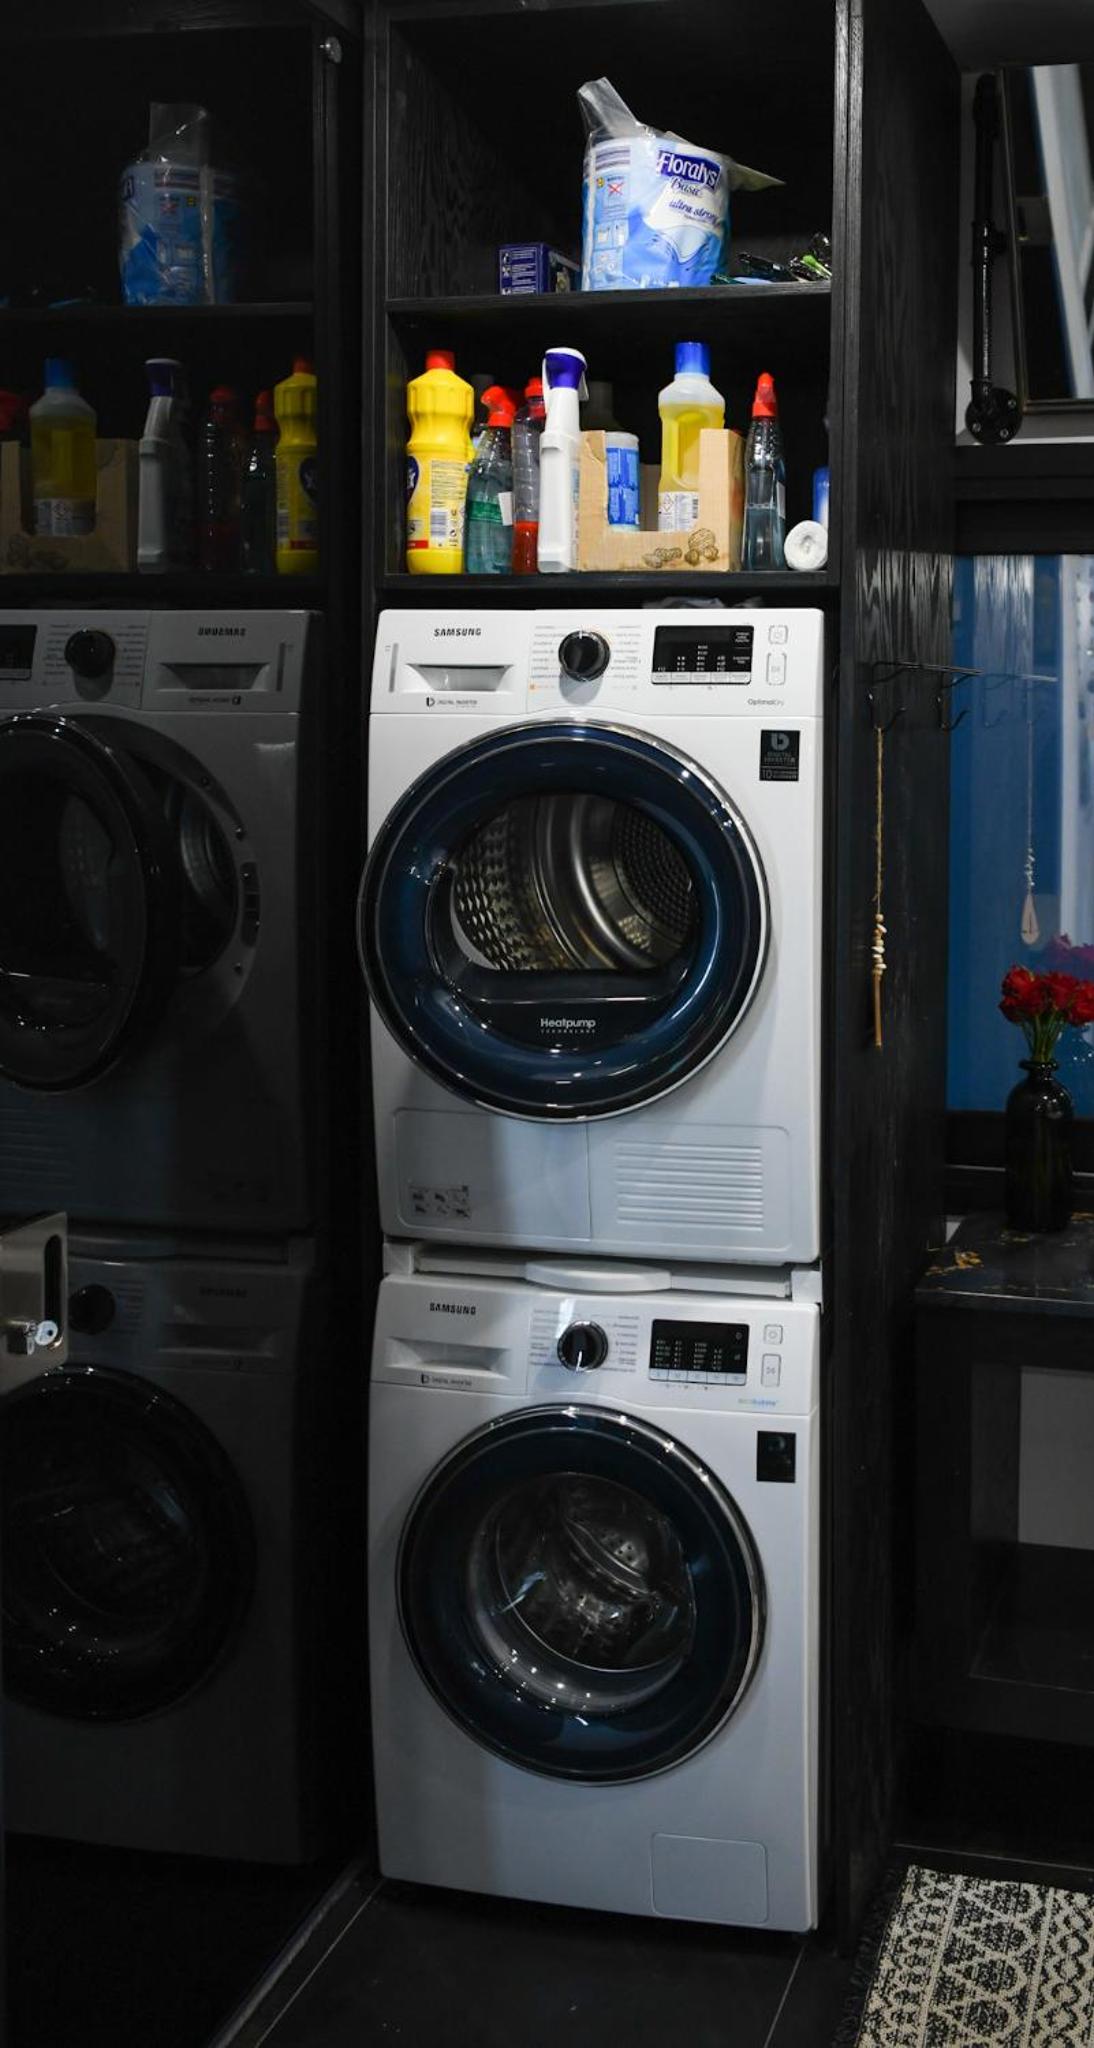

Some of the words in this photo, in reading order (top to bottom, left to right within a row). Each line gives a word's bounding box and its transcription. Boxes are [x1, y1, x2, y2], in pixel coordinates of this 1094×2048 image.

[656, 152, 718, 187] Floralys
[433, 627, 482, 637] SAMSUNG
[540, 1018, 597, 1029] Heatpump
[429, 1302, 477, 1315] SAMSUNG
